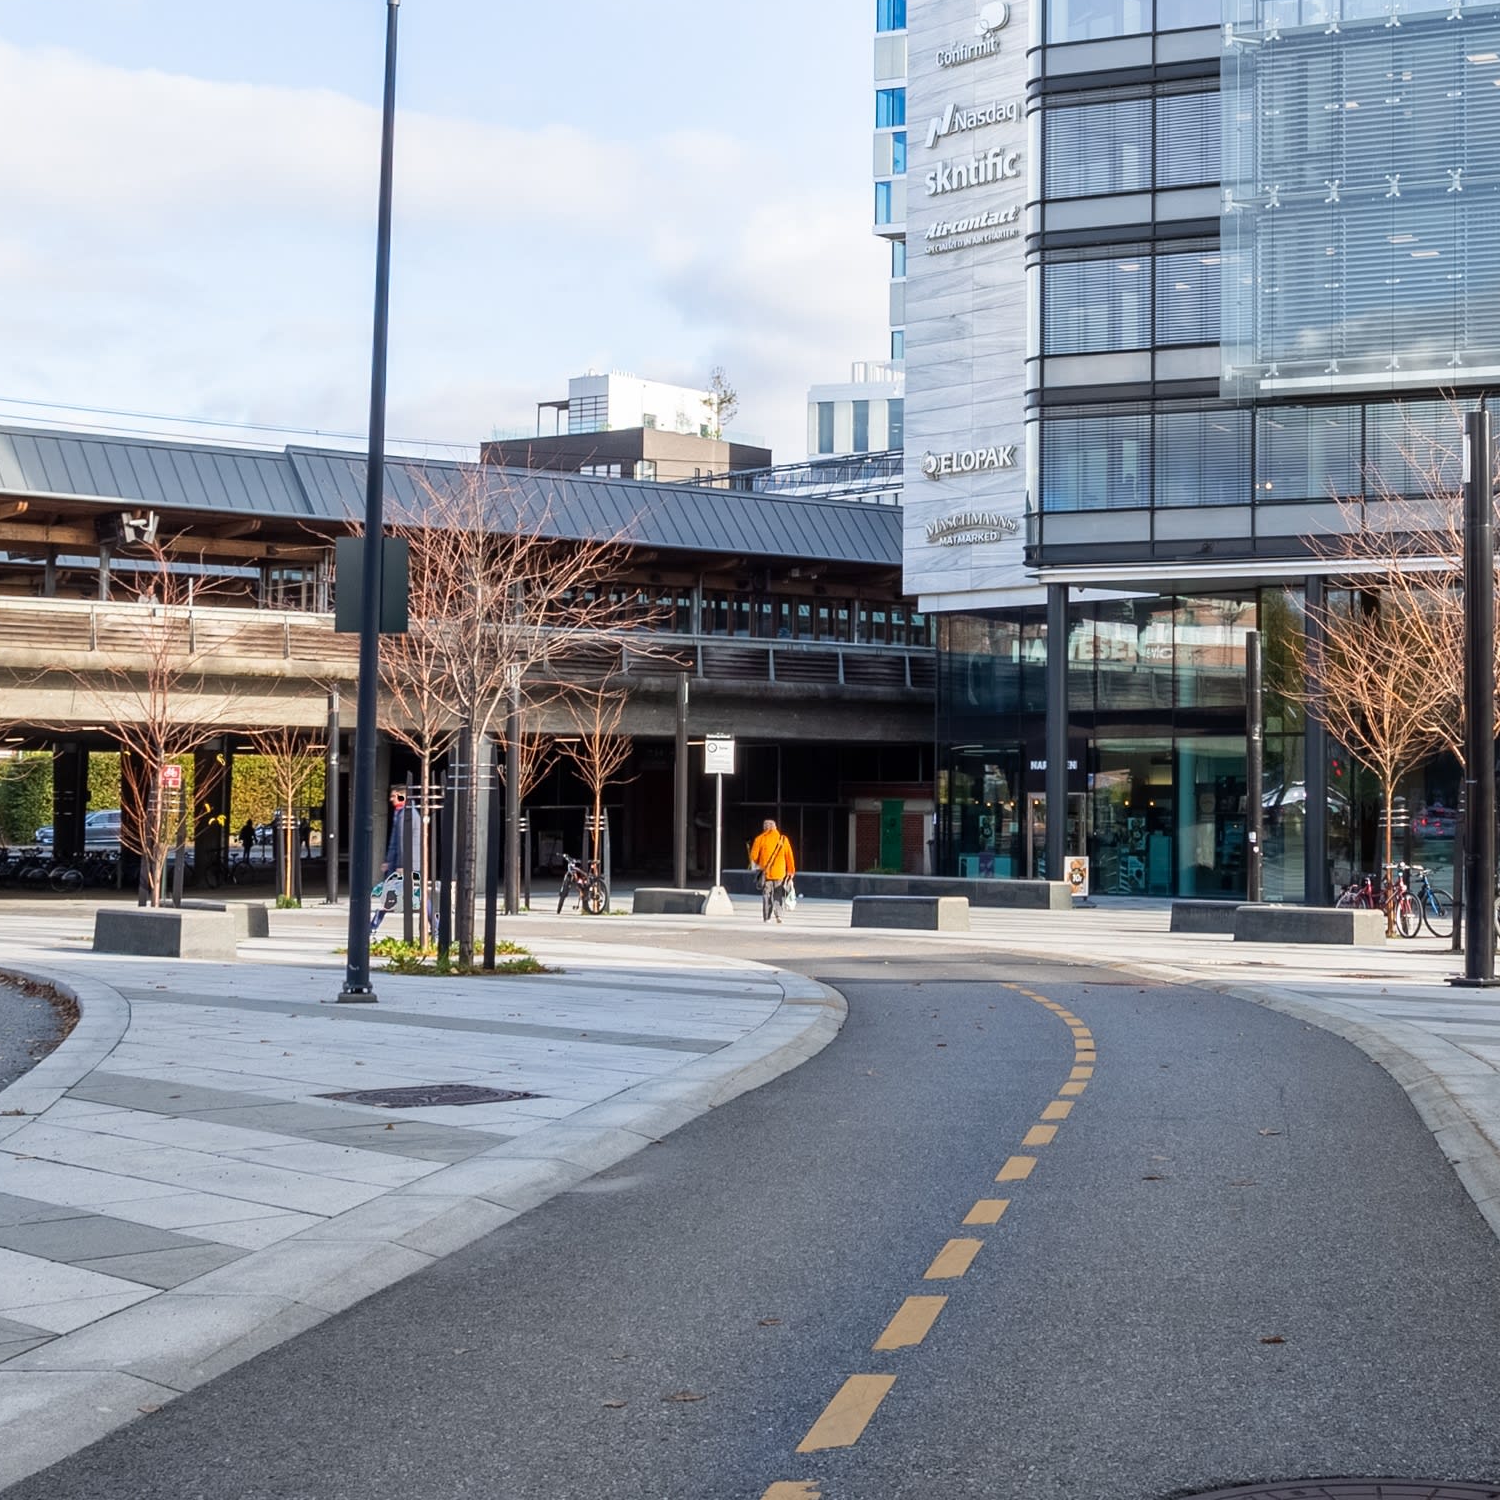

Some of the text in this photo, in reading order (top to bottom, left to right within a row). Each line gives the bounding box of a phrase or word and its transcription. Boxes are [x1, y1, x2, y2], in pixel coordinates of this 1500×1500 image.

[936, 32, 997, 68] Confirmit
[954, 100, 1017, 132] Nasdaq
[925, 147, 1017, 196] skntific
[924, 204, 1018, 240] Aircontact
[940, 445, 1013, 474] ELOPAK
[939, 532, 998, 546] MATMARKED
